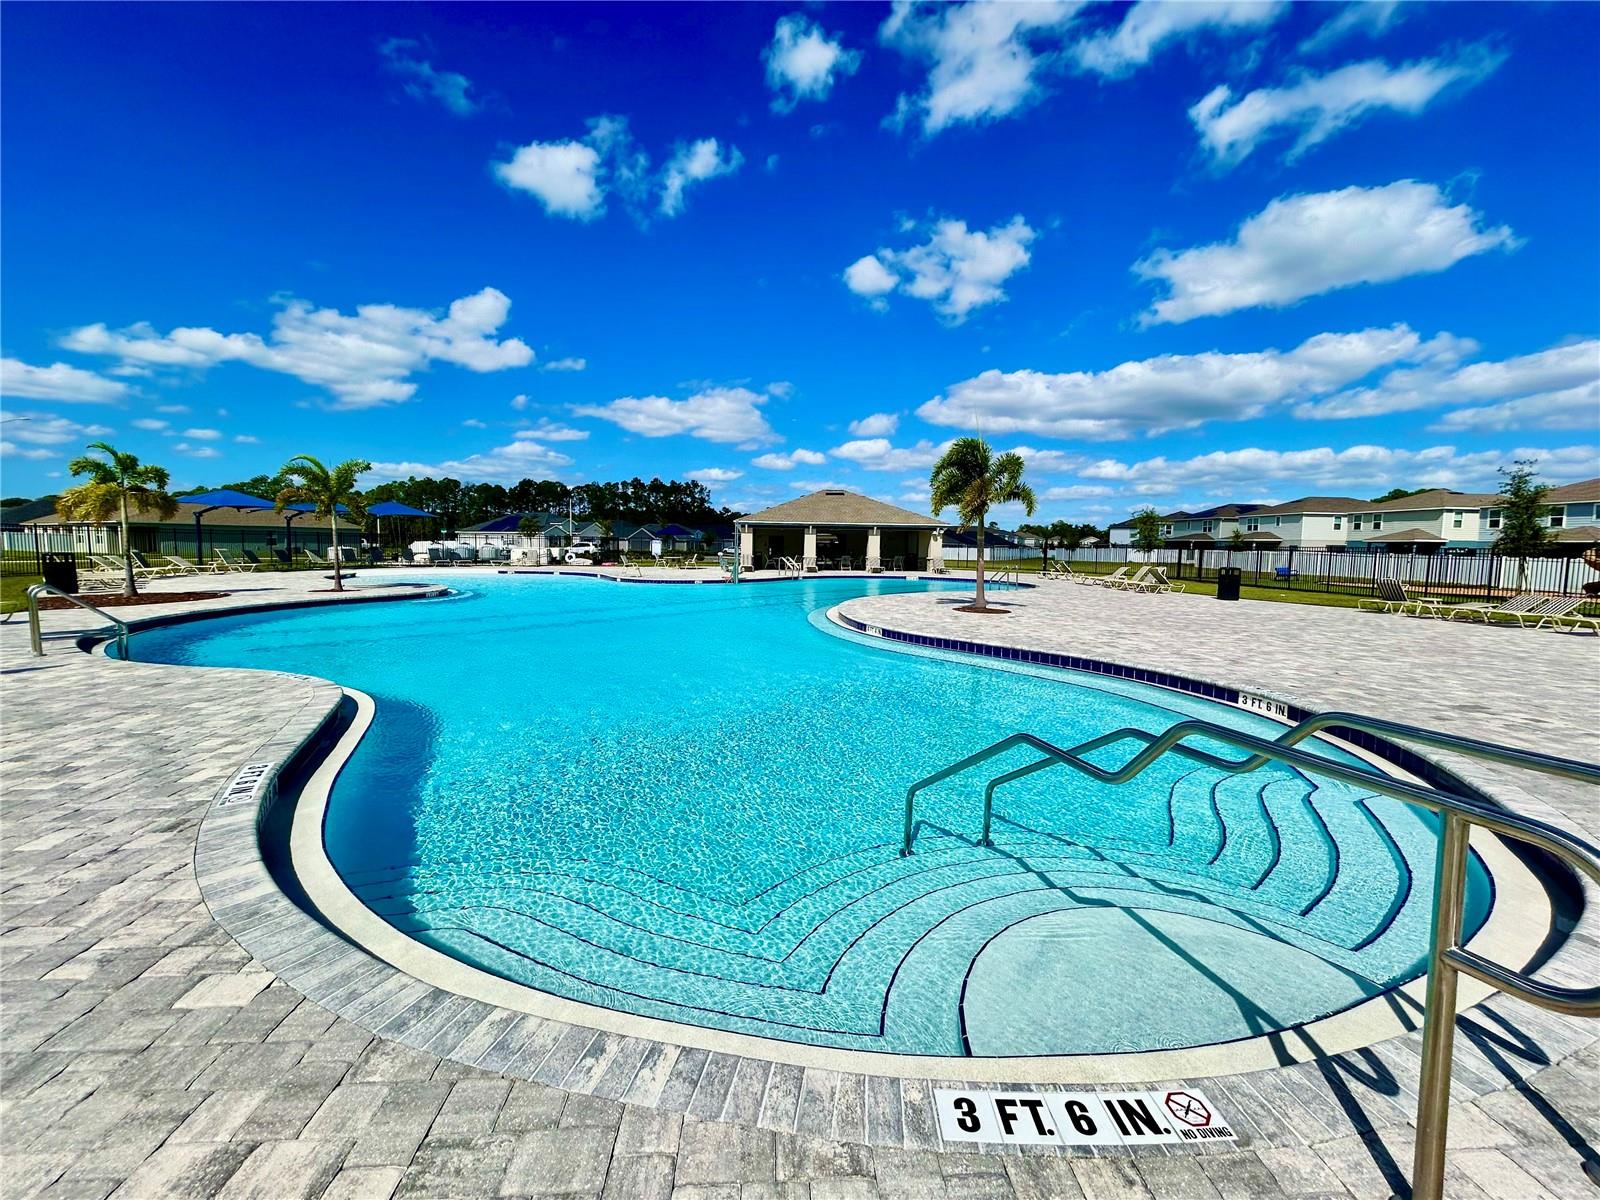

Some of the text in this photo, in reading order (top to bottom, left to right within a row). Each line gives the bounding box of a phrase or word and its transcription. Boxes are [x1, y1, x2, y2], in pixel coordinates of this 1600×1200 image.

[1242, 695, 1248, 704] 3
[1266, 702, 1272, 711] 6
[953, 1097, 1172, 1136] 3 FT. 6 IN.
[1180, 1126, 1233, 1140] NO DIVING
